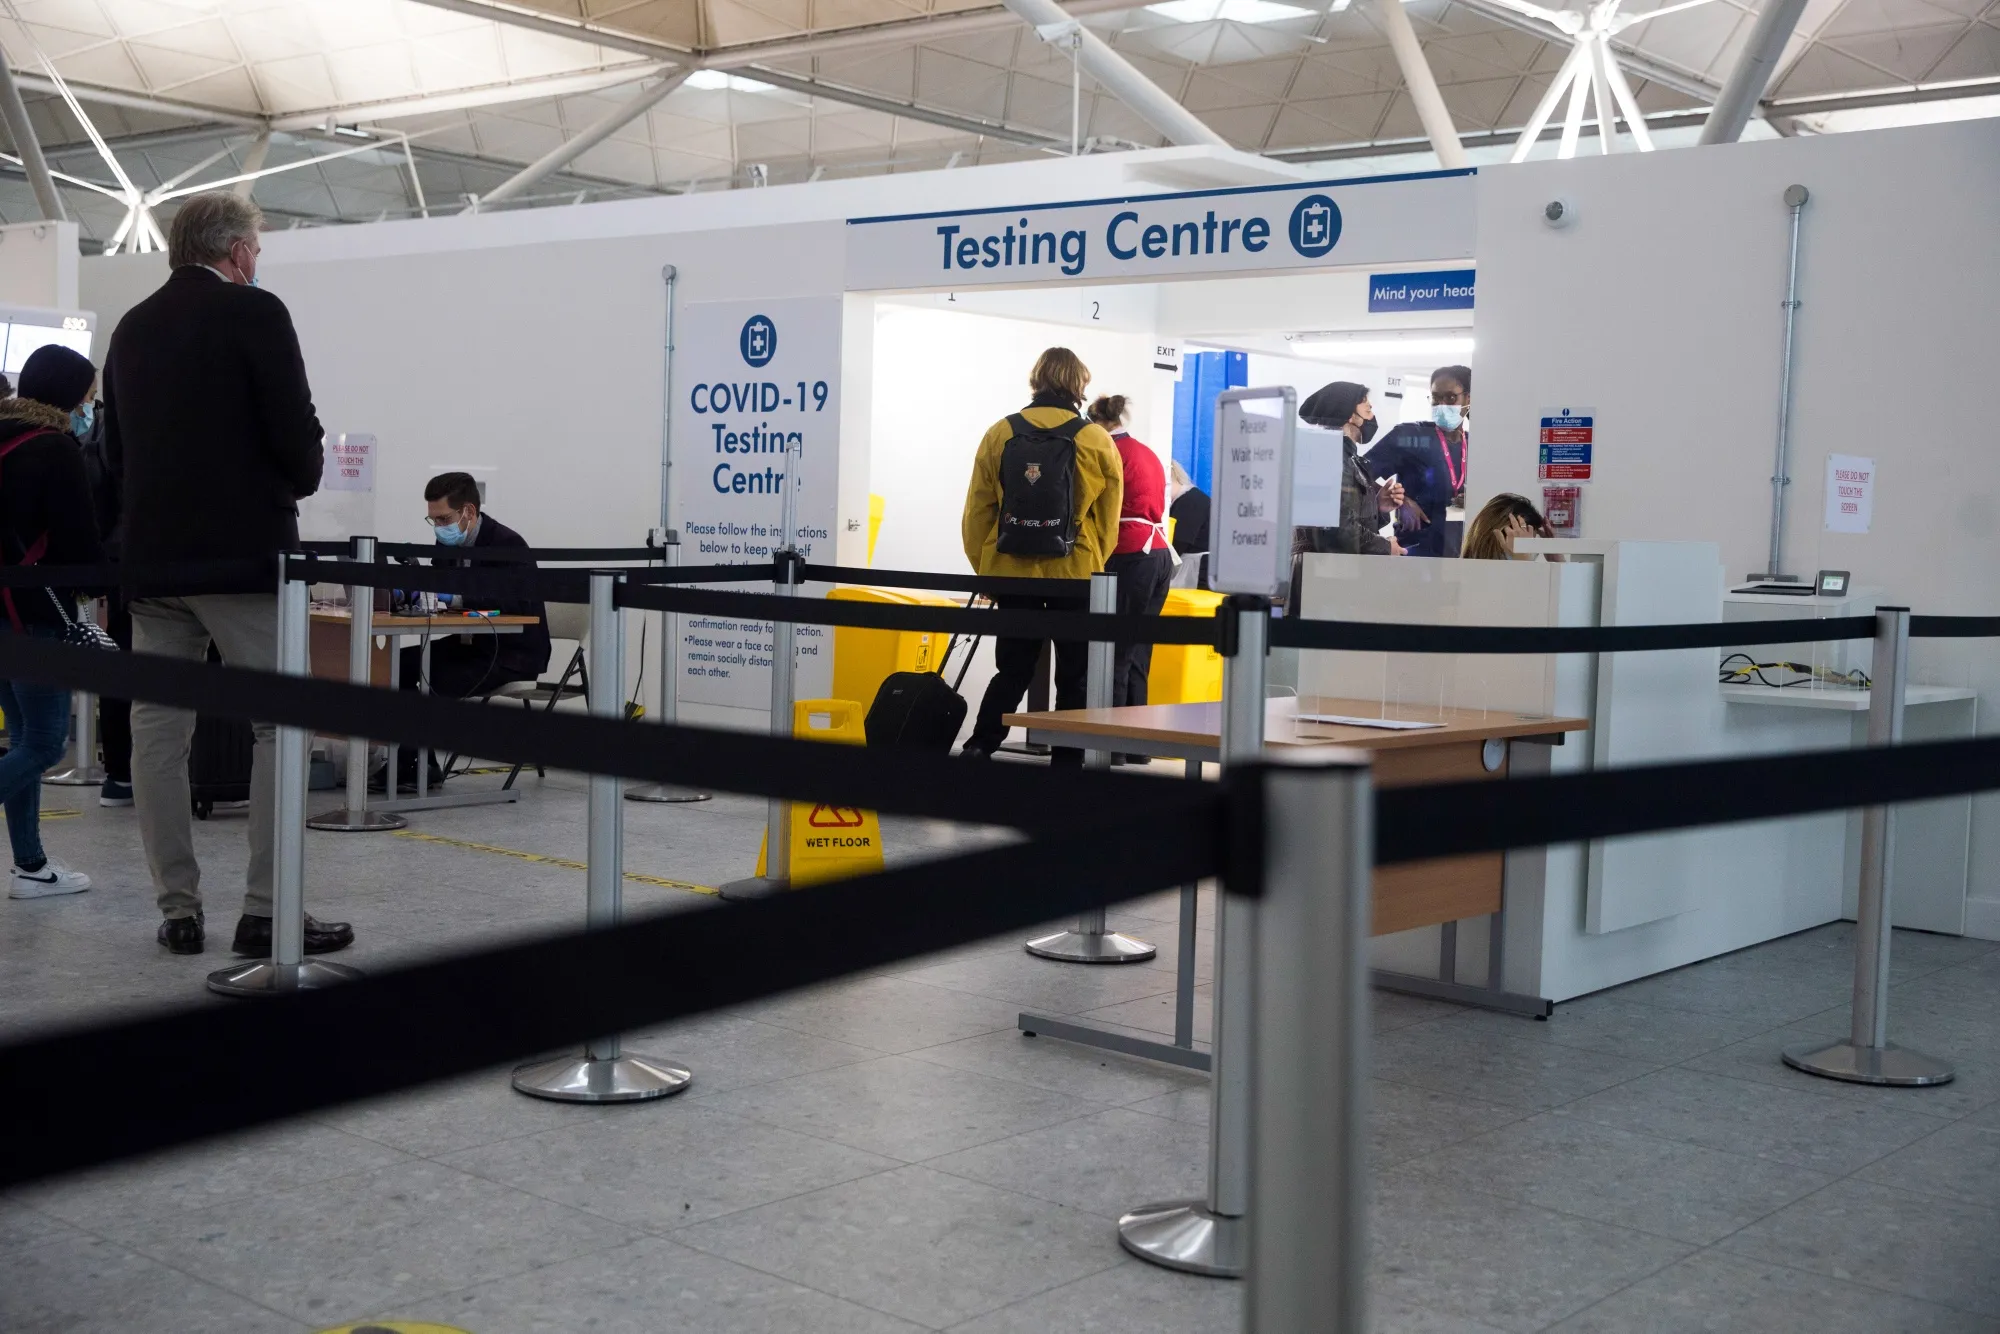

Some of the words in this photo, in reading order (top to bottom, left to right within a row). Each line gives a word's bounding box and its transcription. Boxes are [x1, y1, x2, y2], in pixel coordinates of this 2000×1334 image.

[937, 218, 1087, 276] Testing
[1107, 211, 1271, 261] Centre
[1373, 285, 1407, 300] Mind
[1410, 287, 1440, 302] your
[1092, 301, 1100, 320] 2
[1157, 346, 1176, 357] EXIT
[690, 381, 829, 414] COVID-19
[1240, 420, 1267, 433] Please
[1231, 447, 1251, 462] Wait
[1253, 447, 1274, 462] Here
[713, 463, 801, 494] Centr
[1240, 475, 1250, 490] To
[1252, 475, 1264, 490] Be
[1835, 470, 1850, 479] PLEASE
[1851, 471, 1858, 480] DO
[1858, 472, 1869, 481] NOT
[1838, 486, 1853, 495] TOUCH
[1854, 487, 1863, 496] THE
[1237, 502, 1264, 518] Called
[1841, 502, 1858, 512] SCREEN
[686, 521, 716, 534] Please
[718, 522, 748, 537] follow
[751, 523, 767, 537] the
[770, 524, 828, 538] insctions
[1009, 517, 1061, 527] PLAYERLAYER
[1232, 530, 1268, 545] Forward
[700, 540, 729, 553] below
[731, 543, 741, 554] to
[744, 542, 768, 558] keep
[688, 618, 738, 631] confirmation
[740, 622, 763, 635] ready
[765, 622, 774, 634] fo
[688, 635, 713, 647] Please
[715, 639, 735, 649] wear
[737, 642, 742, 650] a
[744, 639, 762, 651] face
[802, 645, 818, 655] and
[688, 652, 716, 662] remain
[717, 653, 747, 668] socially
[687, 666, 707, 676] each
[708, 668, 731, 679] other.
[806, 838, 830, 848] WET
[832, 838, 871, 847] FLOOR
